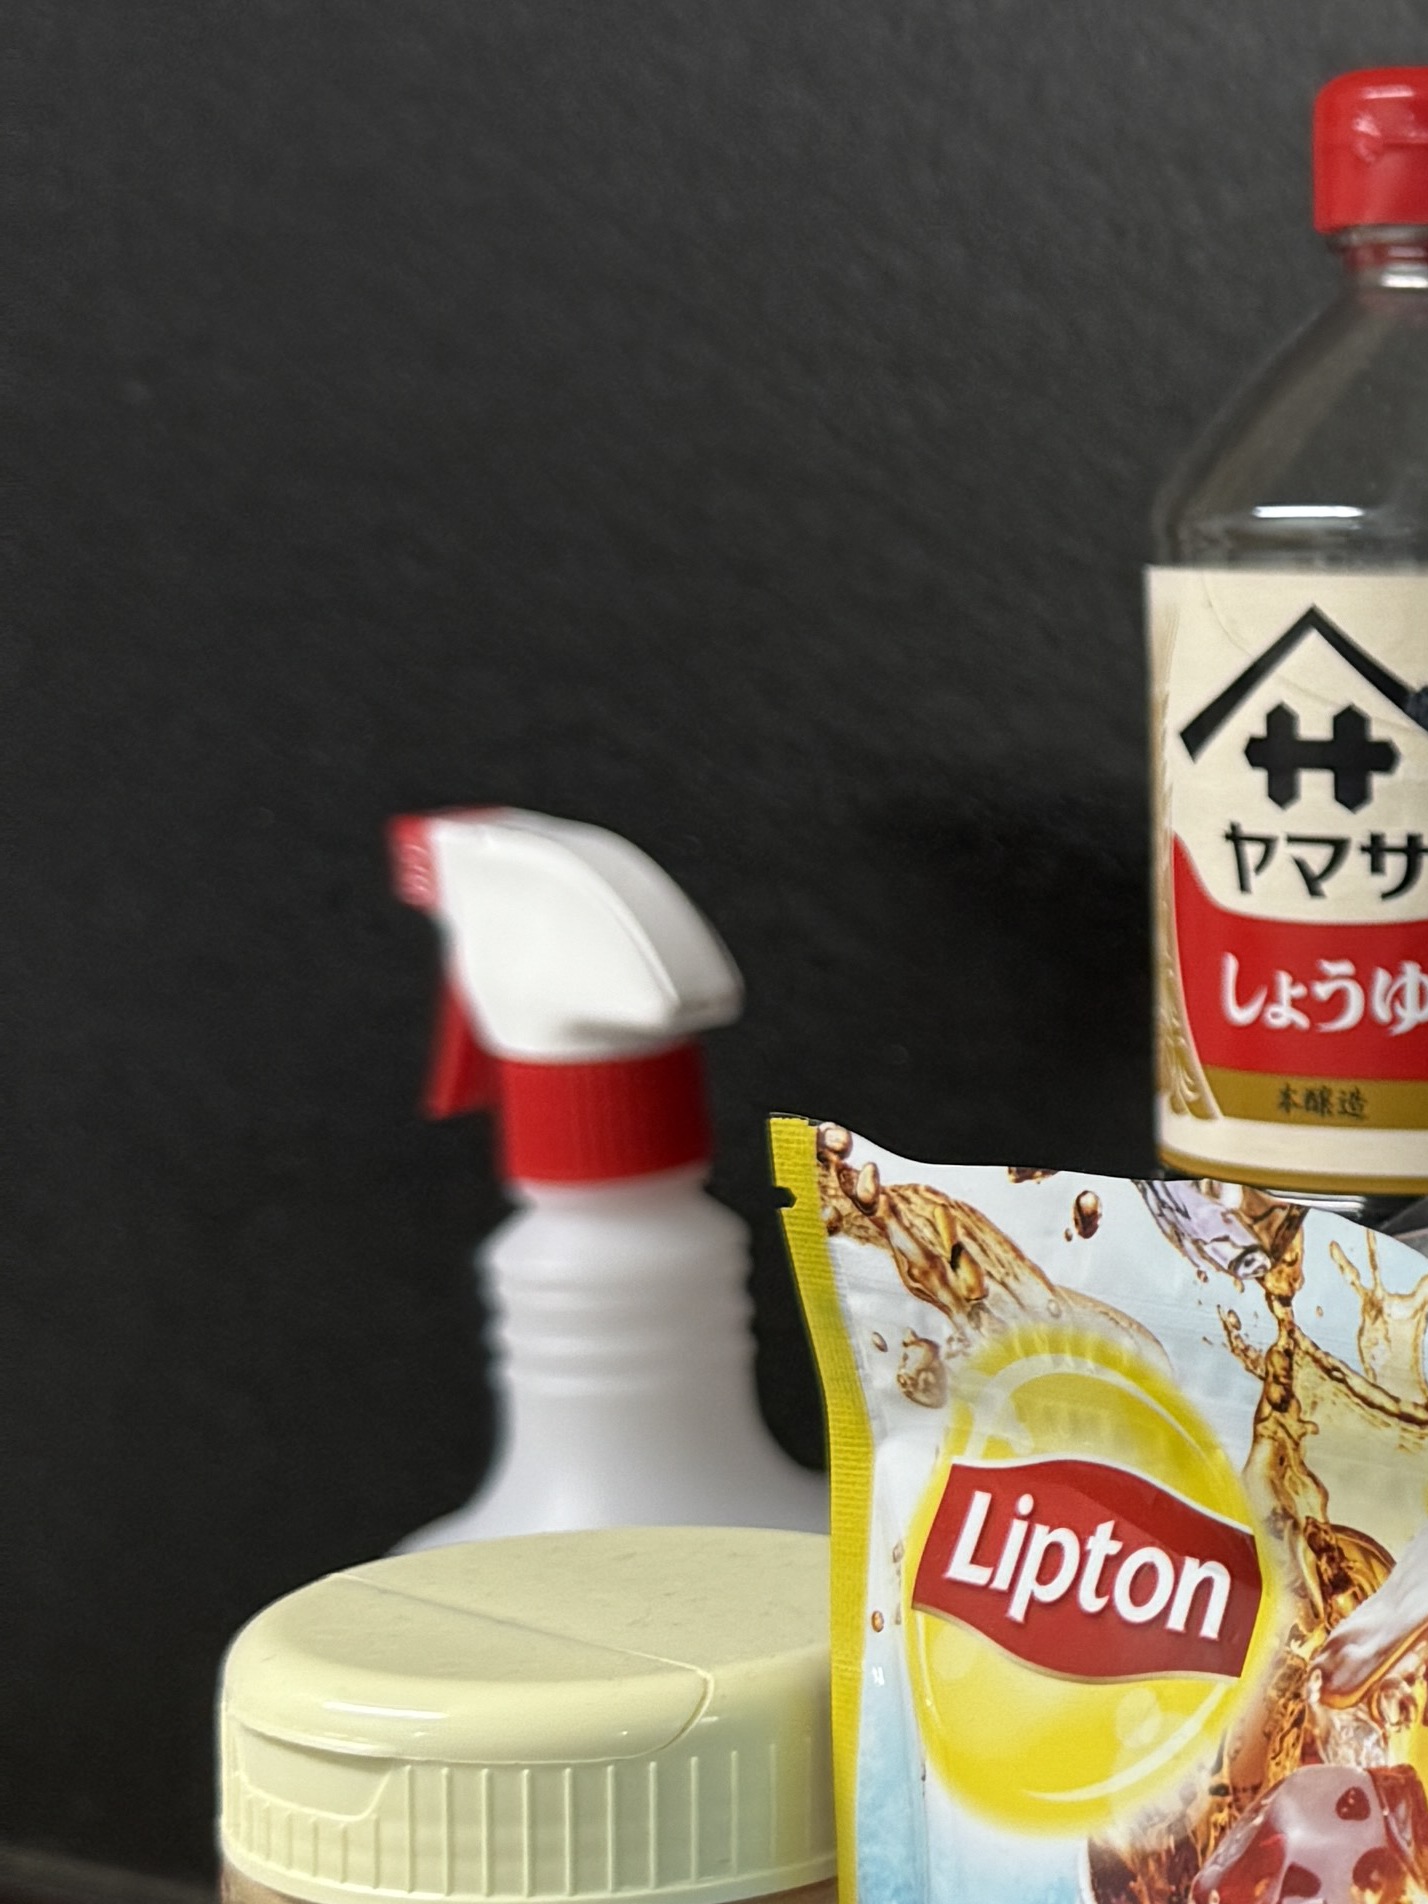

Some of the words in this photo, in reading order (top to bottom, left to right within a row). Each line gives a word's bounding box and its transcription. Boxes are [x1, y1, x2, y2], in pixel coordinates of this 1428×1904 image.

[1277, 1085, 1370, 1120] 本醸造
[943, 1491, 1232, 1641] Lipton
